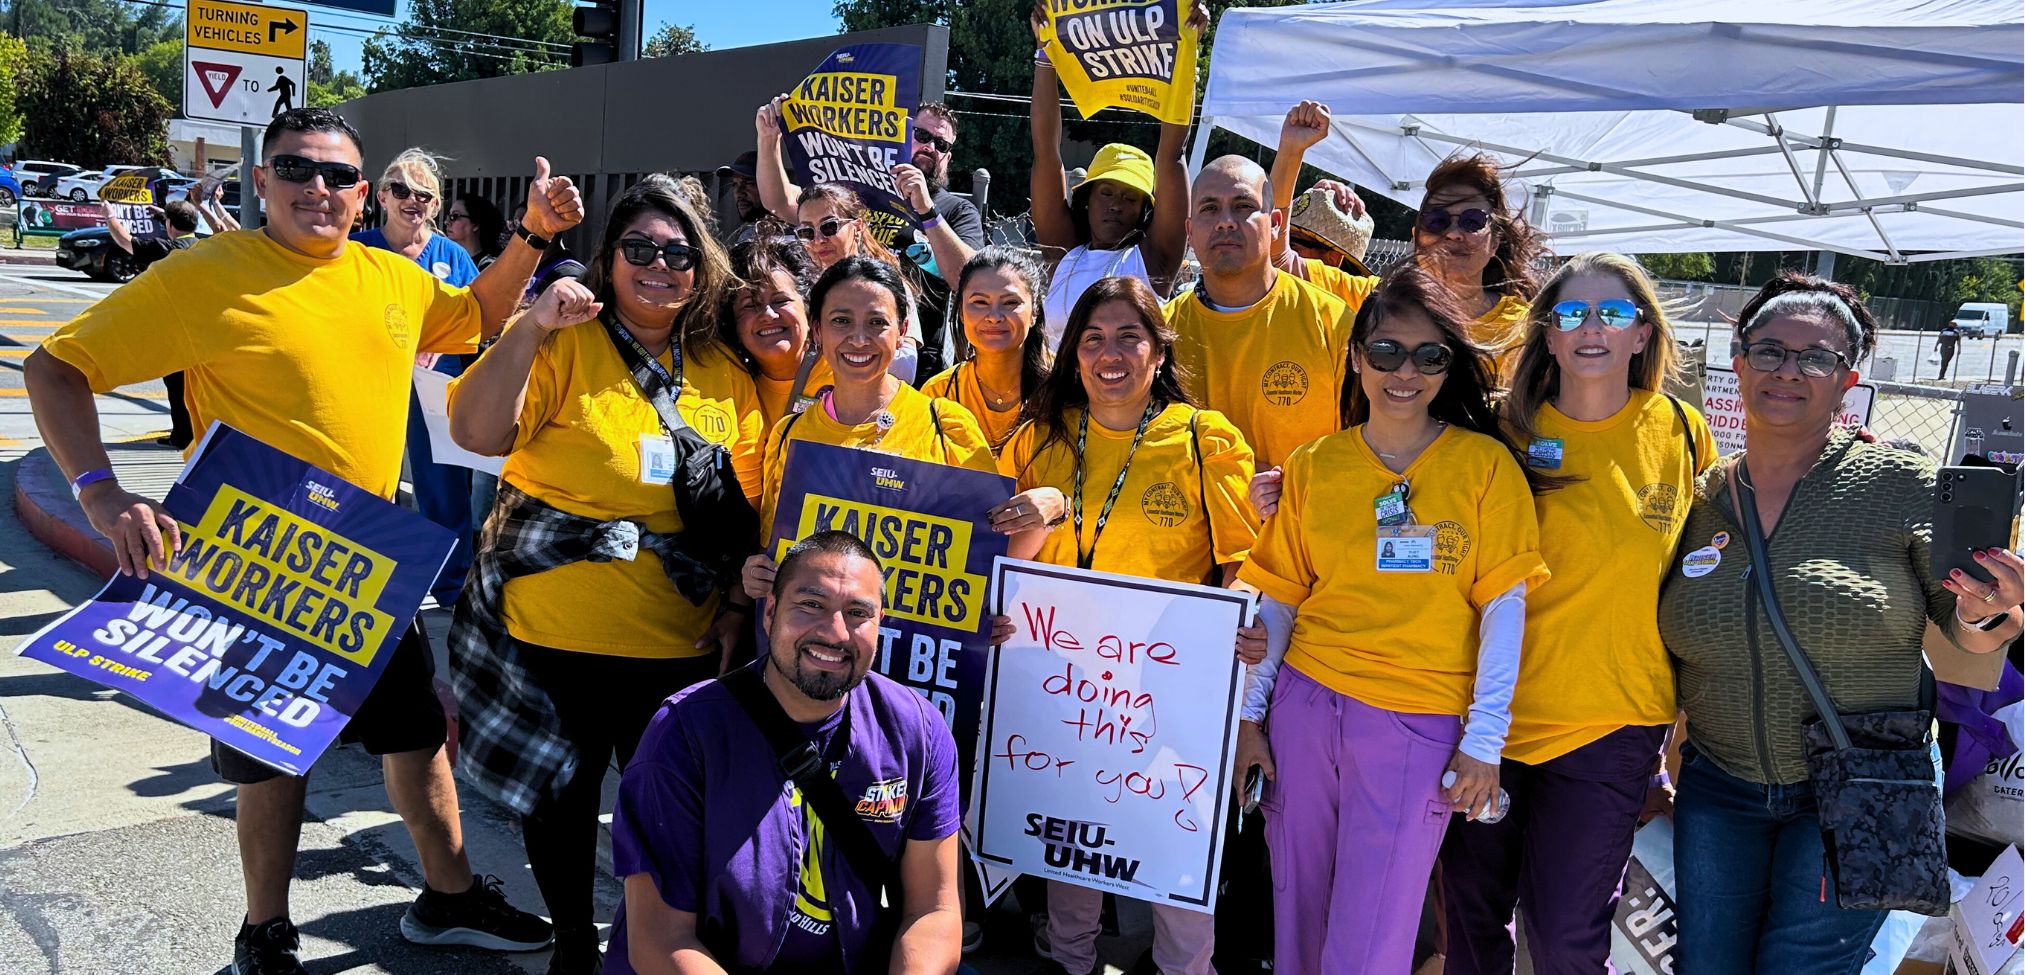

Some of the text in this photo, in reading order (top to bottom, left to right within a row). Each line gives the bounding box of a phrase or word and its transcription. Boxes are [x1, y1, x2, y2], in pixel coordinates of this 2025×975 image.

[198, 7, 258, 26] TURNING
[194, 26, 261, 44] VEHICLES
[1067, 6, 1164, 50] ON ULP
[1083, 43, 1174, 79] STRIKE
[208, 72, 226, 80] YIELD
[243, 80, 259, 92] TO
[800, 76, 885, 105] KAISER
[788, 102, 899, 138] WORKERS
[798, 131, 898, 173] WON'T BE
[113, 178, 144, 188] KAISER
[105, 188, 147, 202] WORKERS
[112, 204, 132, 219] ON'T
[133, 205, 151, 219] BE
[1277, 396, 1291, 406] 770
[700, 414, 726, 434] 770
[1706, 414, 1746, 430] BIDDE
[870, 466, 898, 478] SEIU-
[304, 479, 334, 499] SEIU-
[876, 477, 904, 490] UHW
[307, 492, 340, 511] UHW
[1379, 497, 1397, 506] SOLVE
[1160, 517, 1173, 527] 770
[1381, 506, 1399, 518] CRISIS
[815, 503, 952, 570] KAISER
[1658, 522, 1671, 534] 770
[218, 498, 373, 599] KAISER
[1442, 563, 1455, 575] 770
[168, 531, 376, 653] WORKERS
[127, 582, 348, 704] WON'T BE
[1022, 602, 1180, 665] We are
[53, 640, 152, 682] ULP STRIKE
[908, 634, 962, 689] BE
[92, 618, 321, 729] SILENCED
[1043, 663, 1157, 740] doing
[1061, 708, 1151, 754] this
[994, 734, 1075, 778] for
[1994, 786, 2023, 796] CATER
[1024, 813, 1116, 849] SEIU-
[1044, 844, 1140, 883] UHW
[1043, 868, 1130, 890] United Healthcare Workers West
